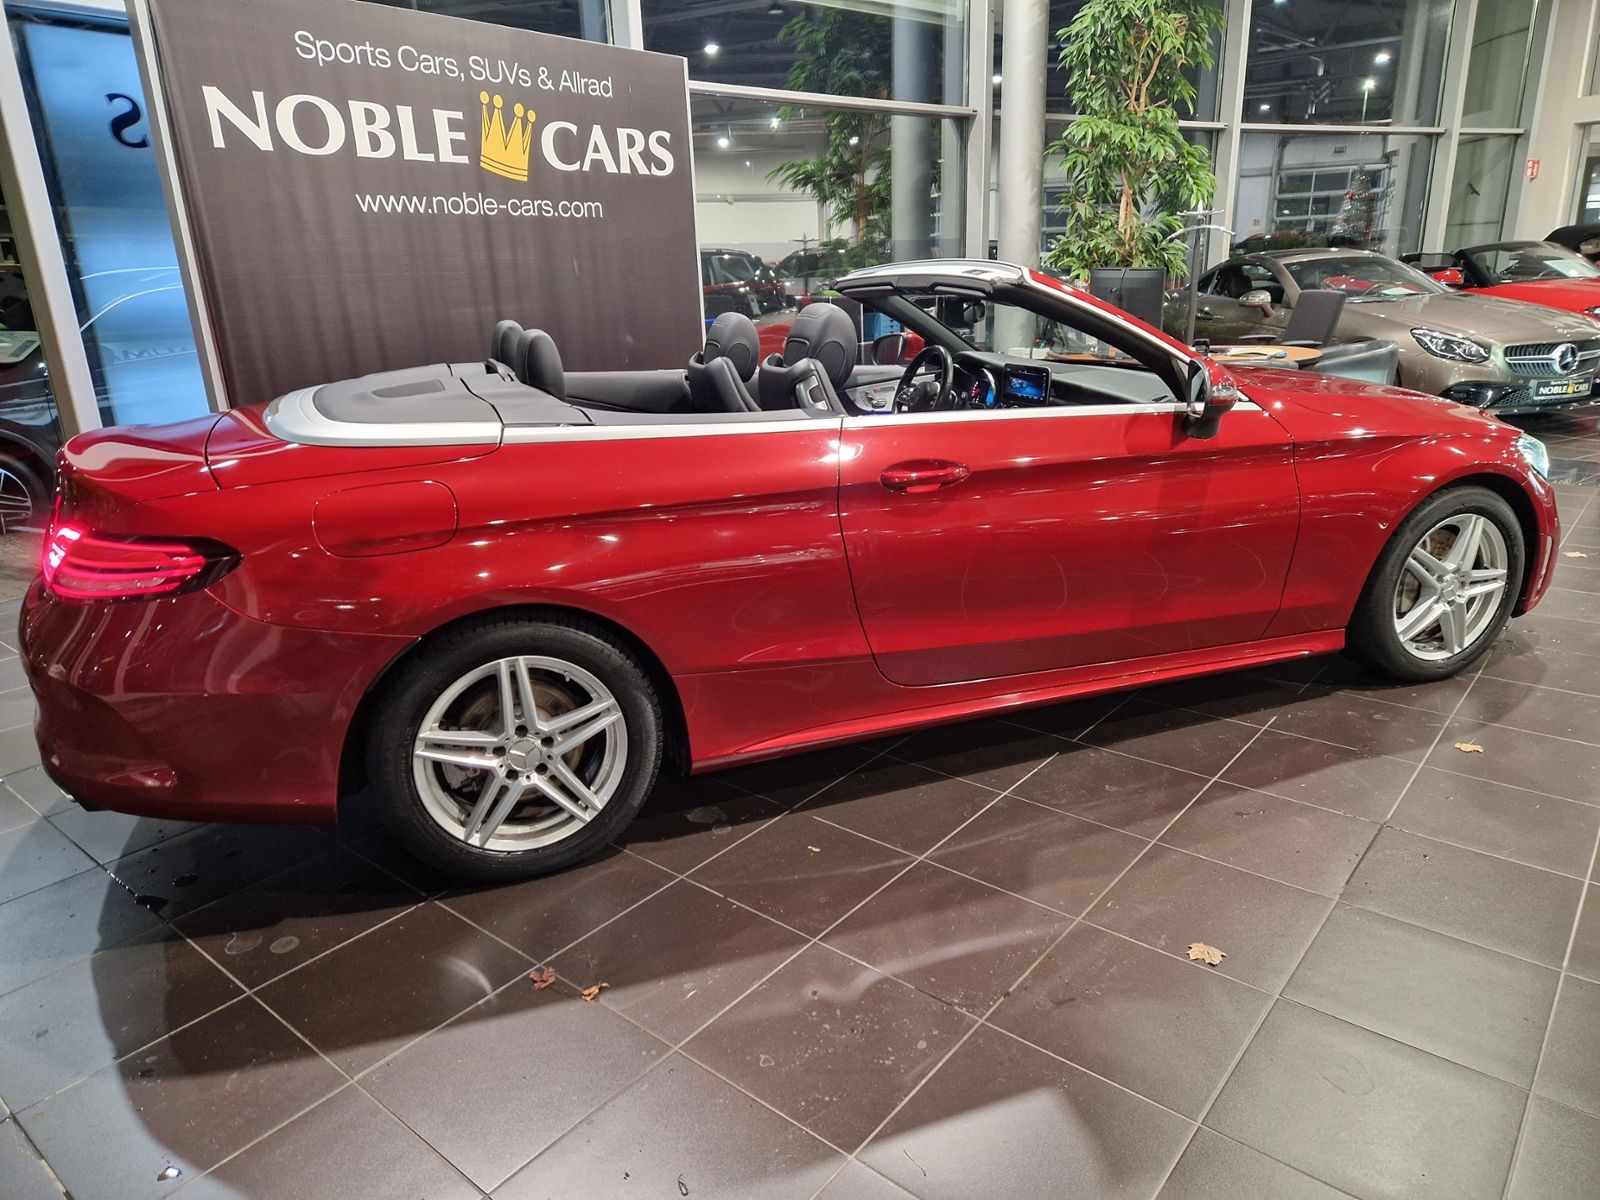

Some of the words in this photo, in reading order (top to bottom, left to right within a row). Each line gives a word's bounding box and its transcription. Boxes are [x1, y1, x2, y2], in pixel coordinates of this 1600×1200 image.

[294, 30, 392, 67] Sports
[397, 45, 465, 82] Cars,
[468, 55, 532, 87] SUVs
[537, 66, 555, 91] &
[558, 69, 613, 98] Allrad
[201, 85, 470, 164] NOBLE
[540, 120, 675, 177] CARS
[355, 191, 604, 218] www.noble-cars.com
[1539, 385, 1567, 394] NOBLE
